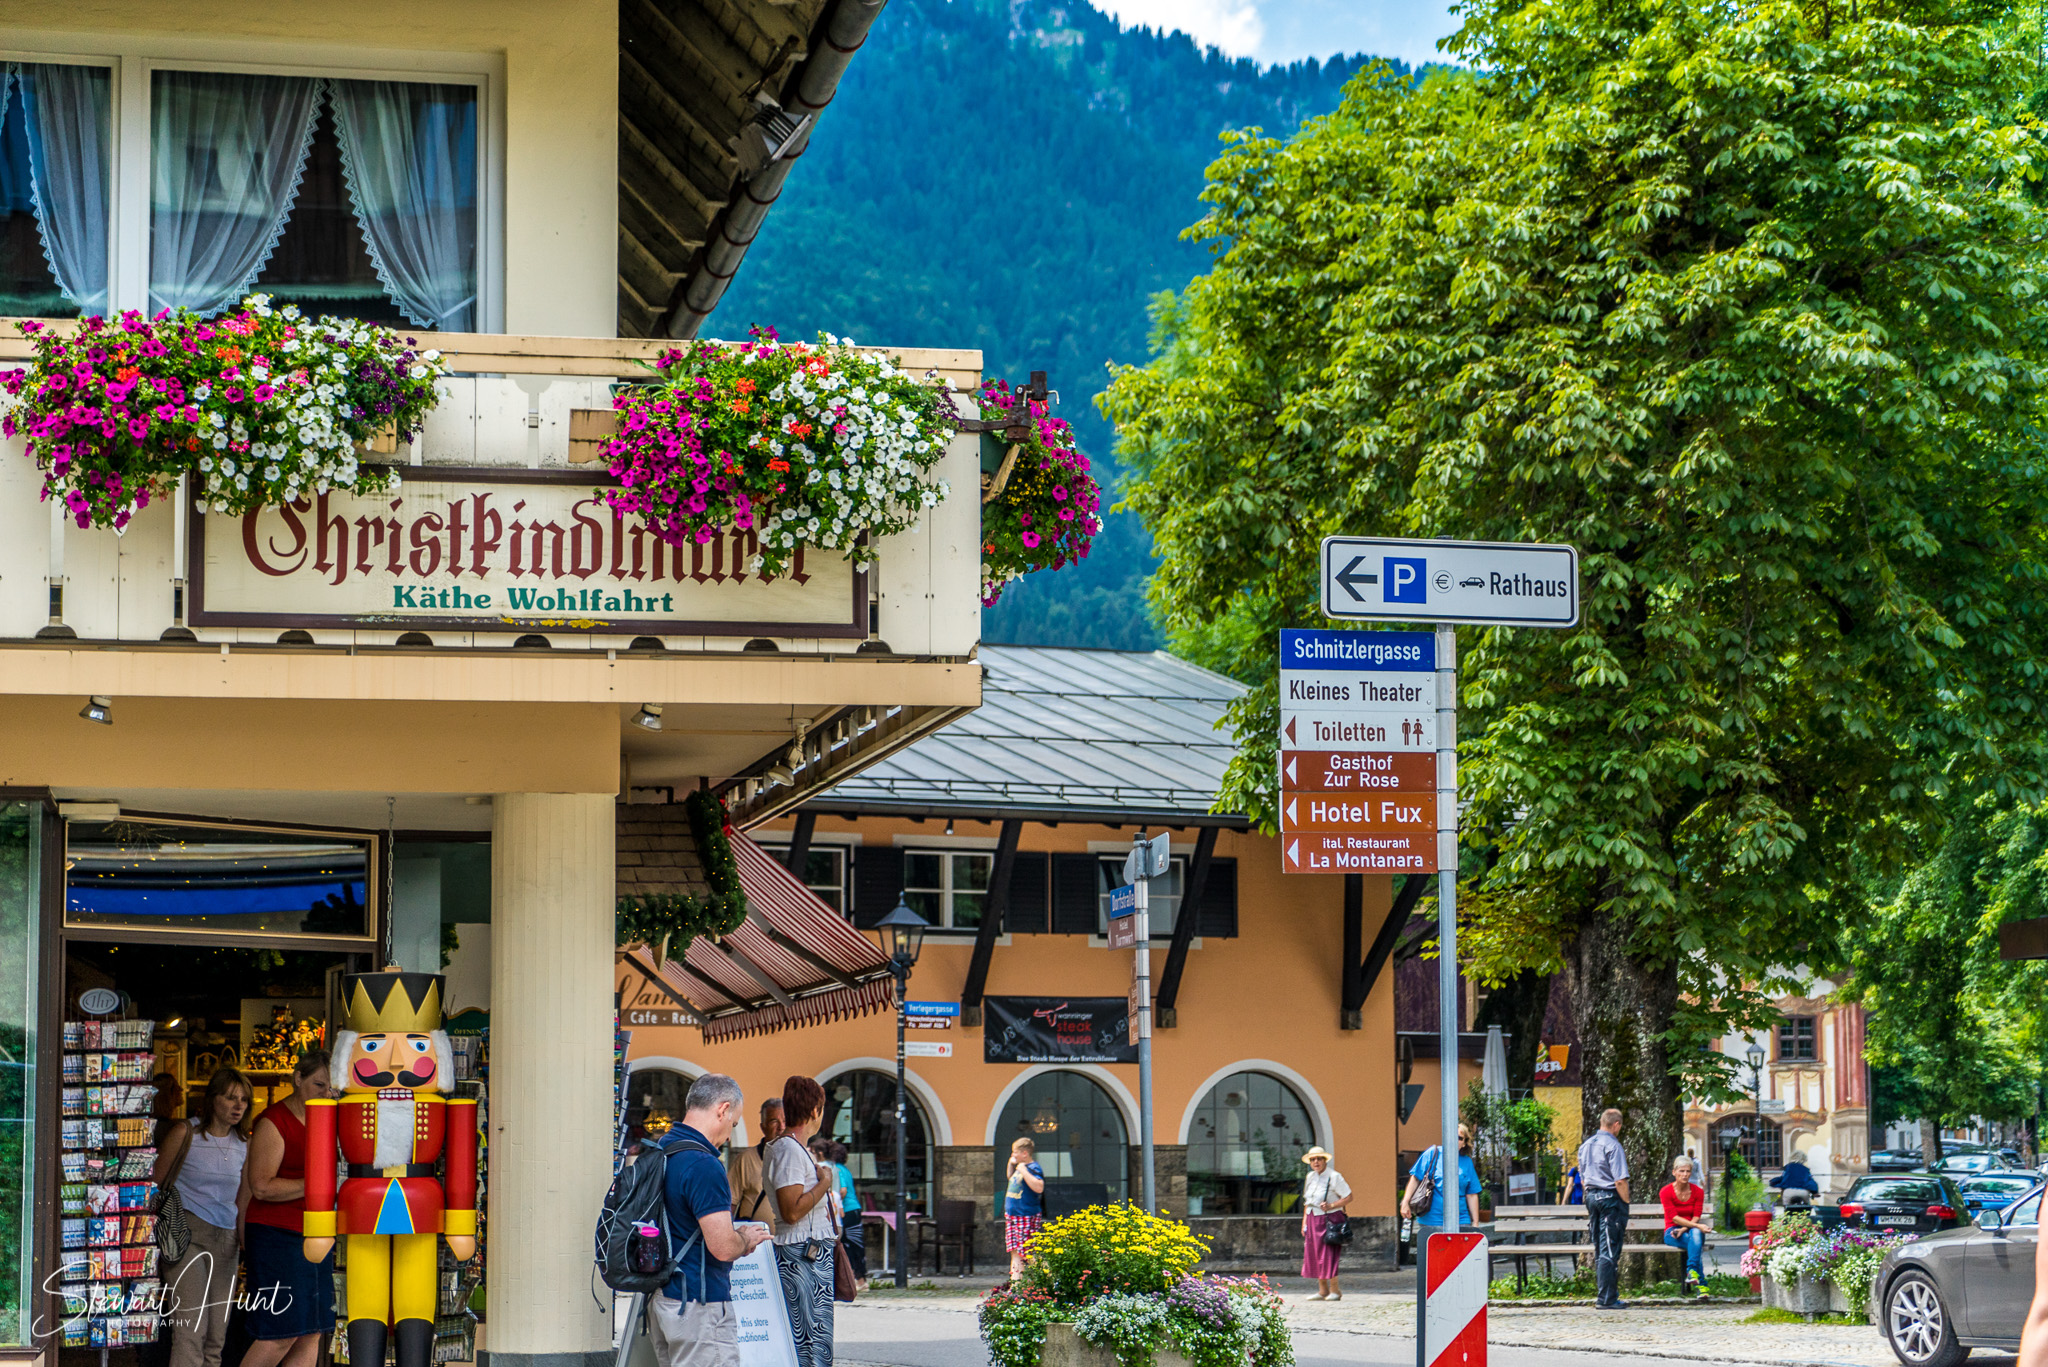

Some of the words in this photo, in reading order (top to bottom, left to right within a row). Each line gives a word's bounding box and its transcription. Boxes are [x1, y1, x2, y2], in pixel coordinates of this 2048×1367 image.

[1393, 563, 1416, 597] P
[1490, 572, 1567, 598] Rathaus
[393, 585, 493, 610] Käthe
[507, 588, 674, 613] Wohlfahrt
[1294, 638, 1421, 664] Schnitzlergasse
[1289, 680, 1350, 701] Kleines
[1359, 681, 1422, 702] Theater
[1312, 721, 1386, 743] Toiletten
[1330, 755, 1393, 771] Gasthof
[1323, 772, 1352, 787] Zur
[1359, 772, 1400, 788] Rose
[1311, 802, 1371, 823] Hotel
[1381, 802, 1422, 823] Fux
[1322, 837, 1344, 849] ital.
[1347, 838, 1410, 849] Restaurant
[1310, 853, 1330, 868] La
[1336, 852, 1424, 868] Montanara
[630, 1010, 658, 1024] Cafe
[1056, 1021, 1092, 1032] steak
[1056, 1034, 1092, 1045] house
[731, 1274, 764, 1289] angenehm
[741, 1317, 753, 1327] this
[754, 1318, 769, 1327] store
